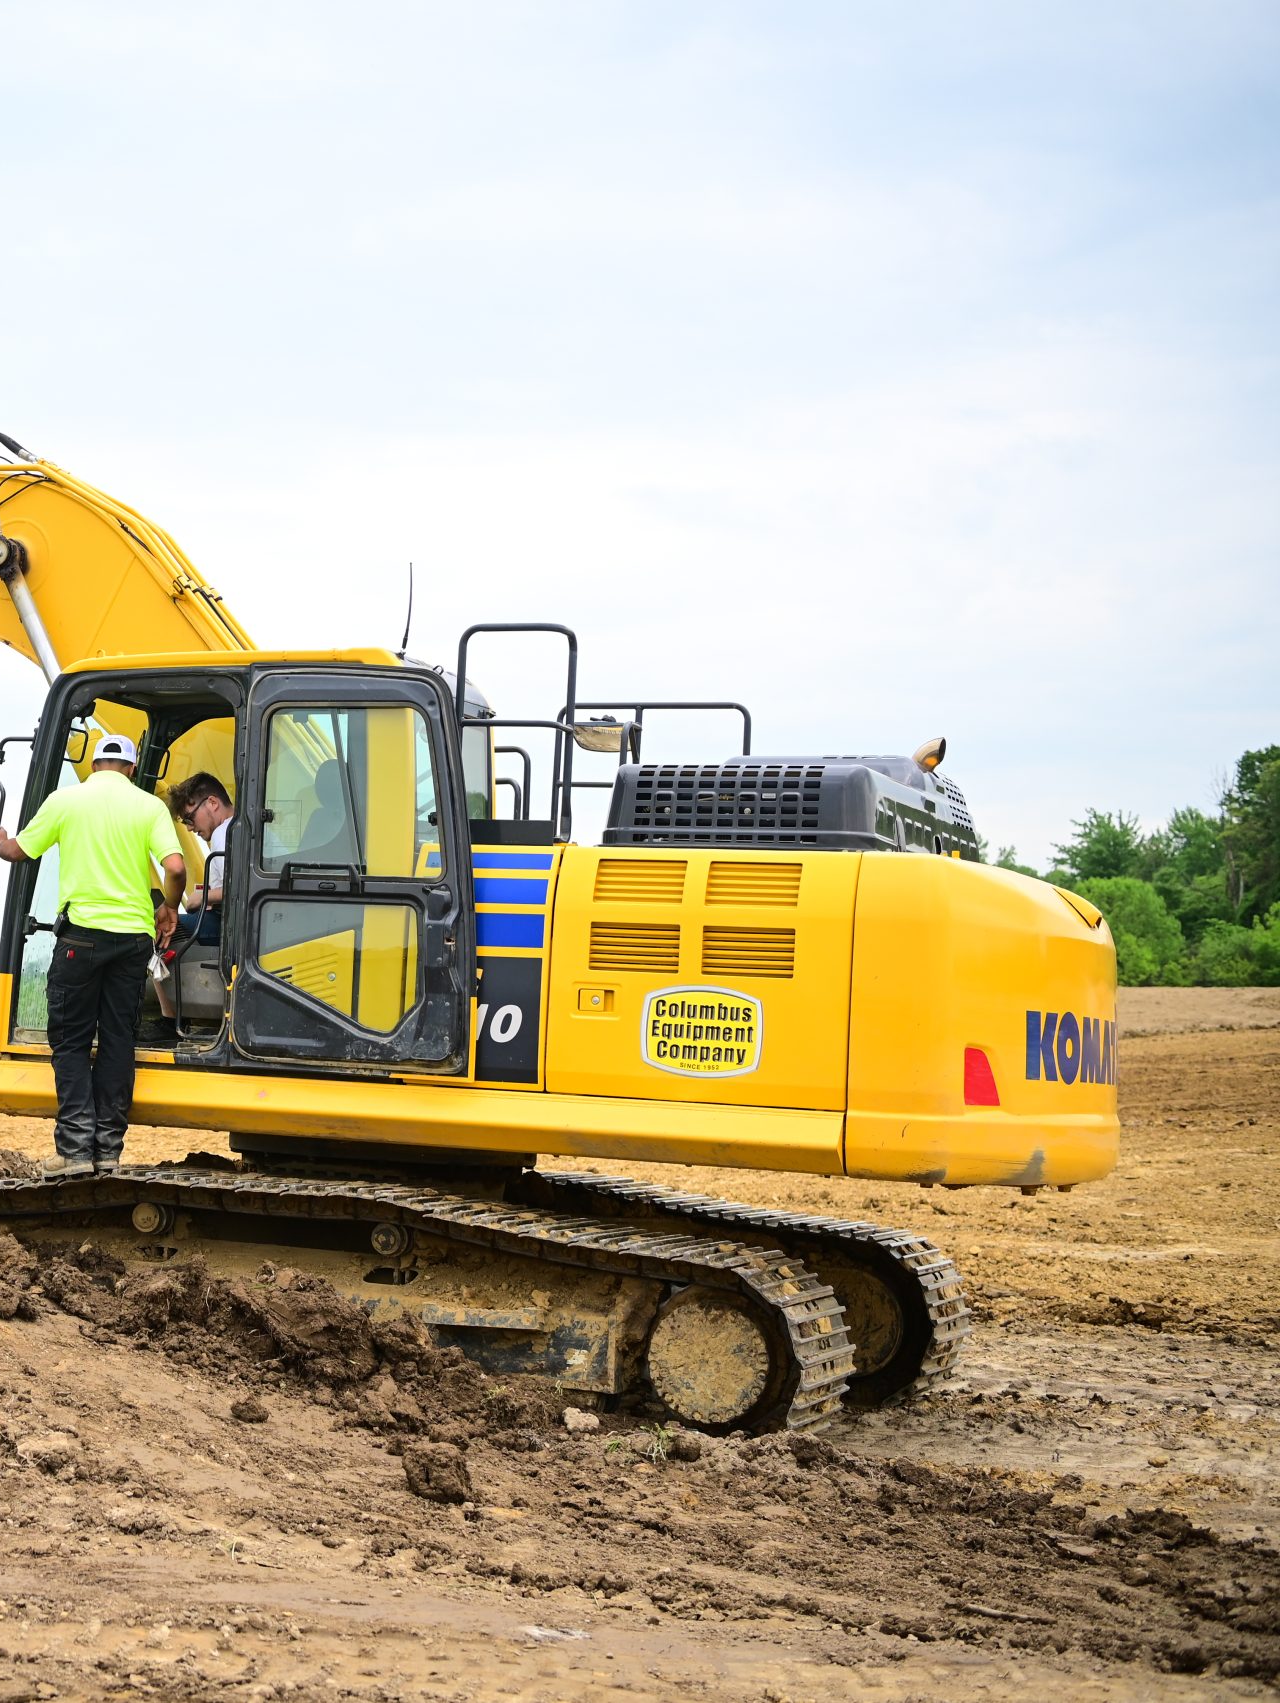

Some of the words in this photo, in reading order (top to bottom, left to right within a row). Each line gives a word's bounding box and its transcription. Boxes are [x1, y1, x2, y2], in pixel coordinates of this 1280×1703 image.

[656, 999, 752, 1022] Columbus
[652, 1020, 753, 1043] Equipment
[657, 1040, 746, 1065] Company
[680, 1062, 700, 1070] SINCE
